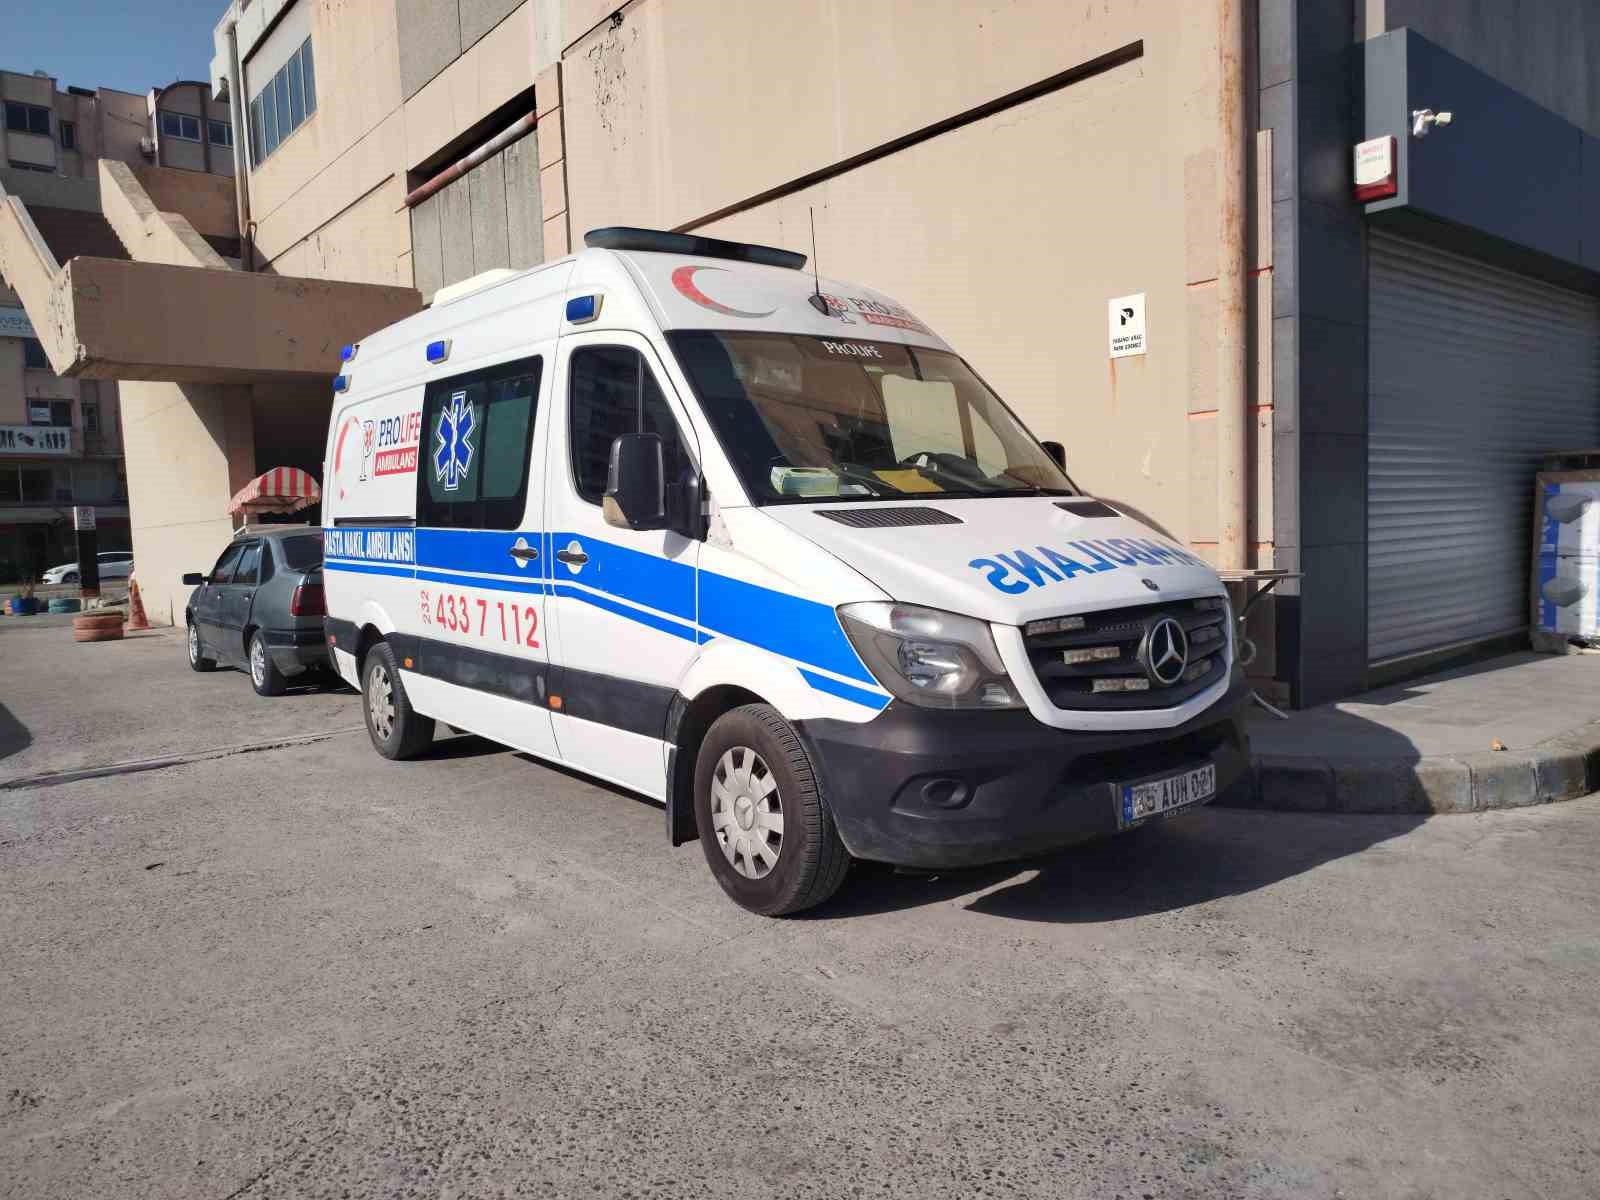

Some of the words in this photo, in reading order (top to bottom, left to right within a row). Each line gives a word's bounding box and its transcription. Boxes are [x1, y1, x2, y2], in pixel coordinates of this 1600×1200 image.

[822, 341, 883, 358] PROLIFE
[378, 411, 421, 447] PROLIFE
[376, 451, 415, 473] AMBULANS
[323, 530, 344, 555] HASTA
[367, 531, 413, 562] AMBULANSI
[421, 590, 431, 624] 232
[437, 594, 470, 633] 433
[477, 599, 487, 637] 7
[498, 602, 539, 648] 112
